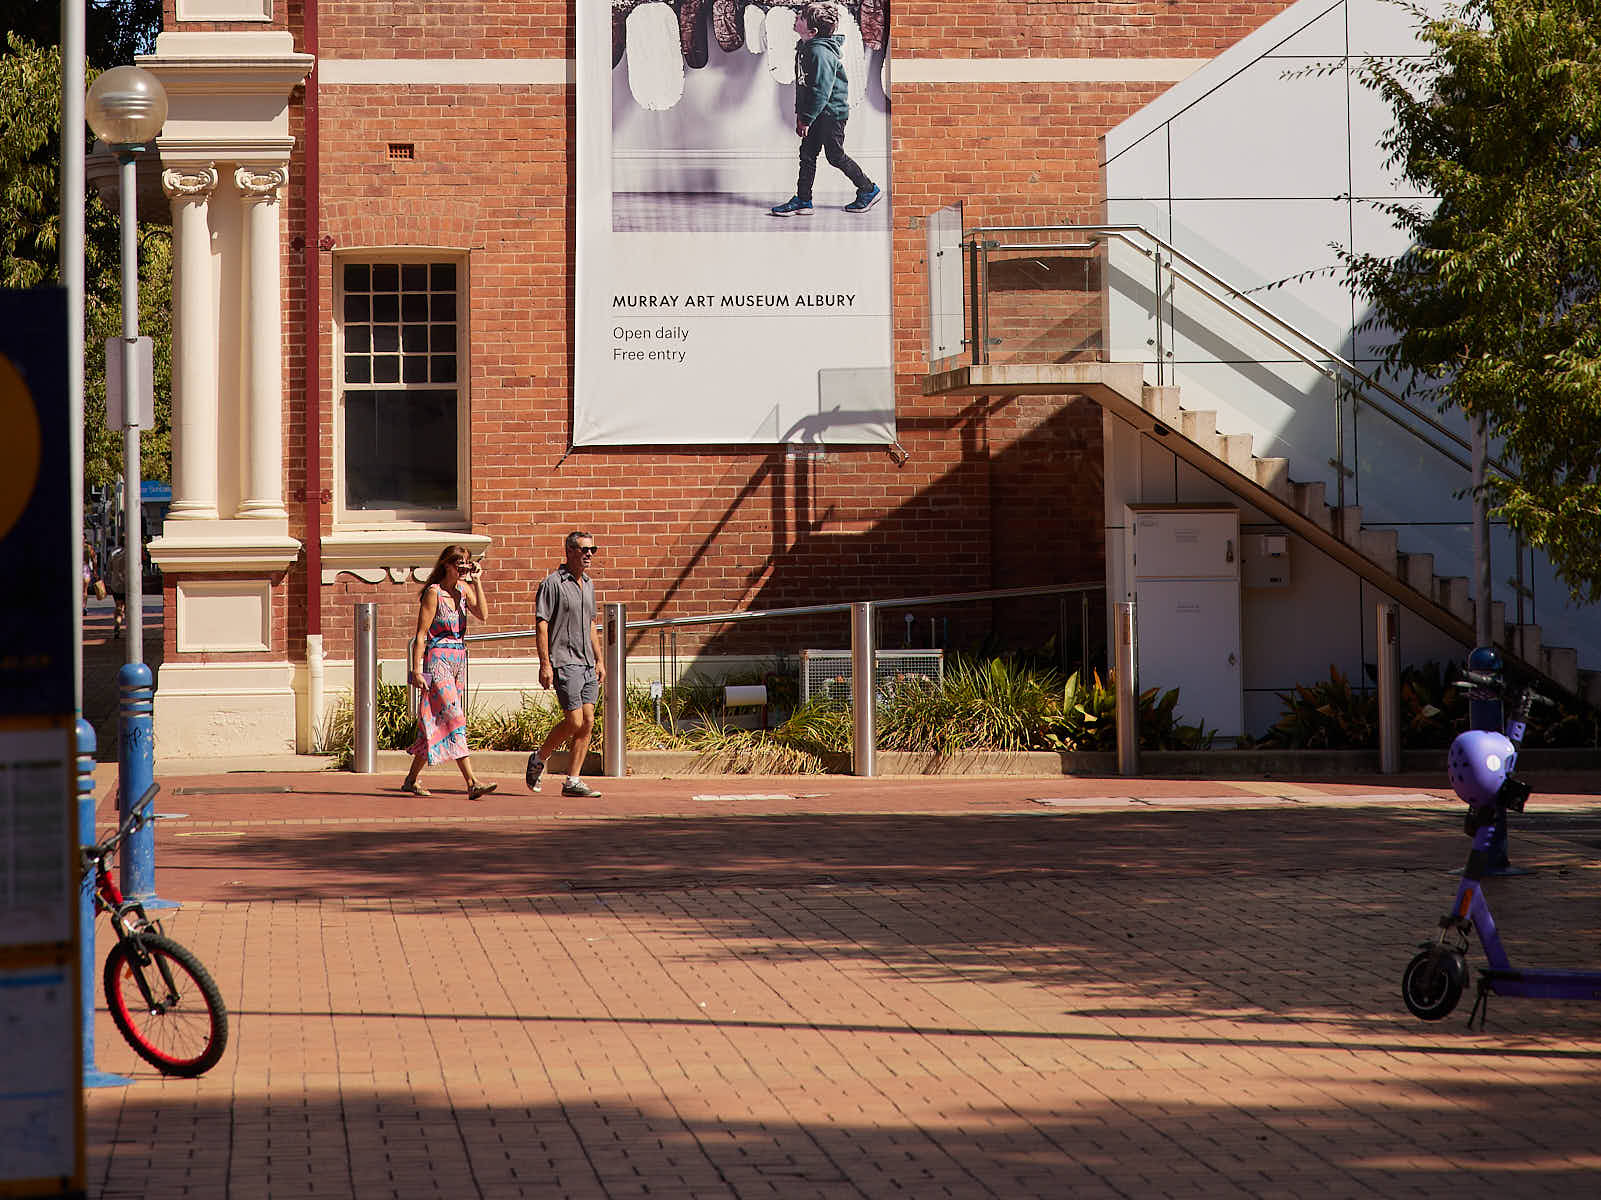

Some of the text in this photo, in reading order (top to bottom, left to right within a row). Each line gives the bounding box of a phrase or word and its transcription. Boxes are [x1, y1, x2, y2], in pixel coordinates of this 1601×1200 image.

[612, 294, 856, 308] MURRAY ART MUSEUM ALBURY
[613, 325, 690, 343] Open daily
[613, 347, 686, 364] Free entry
